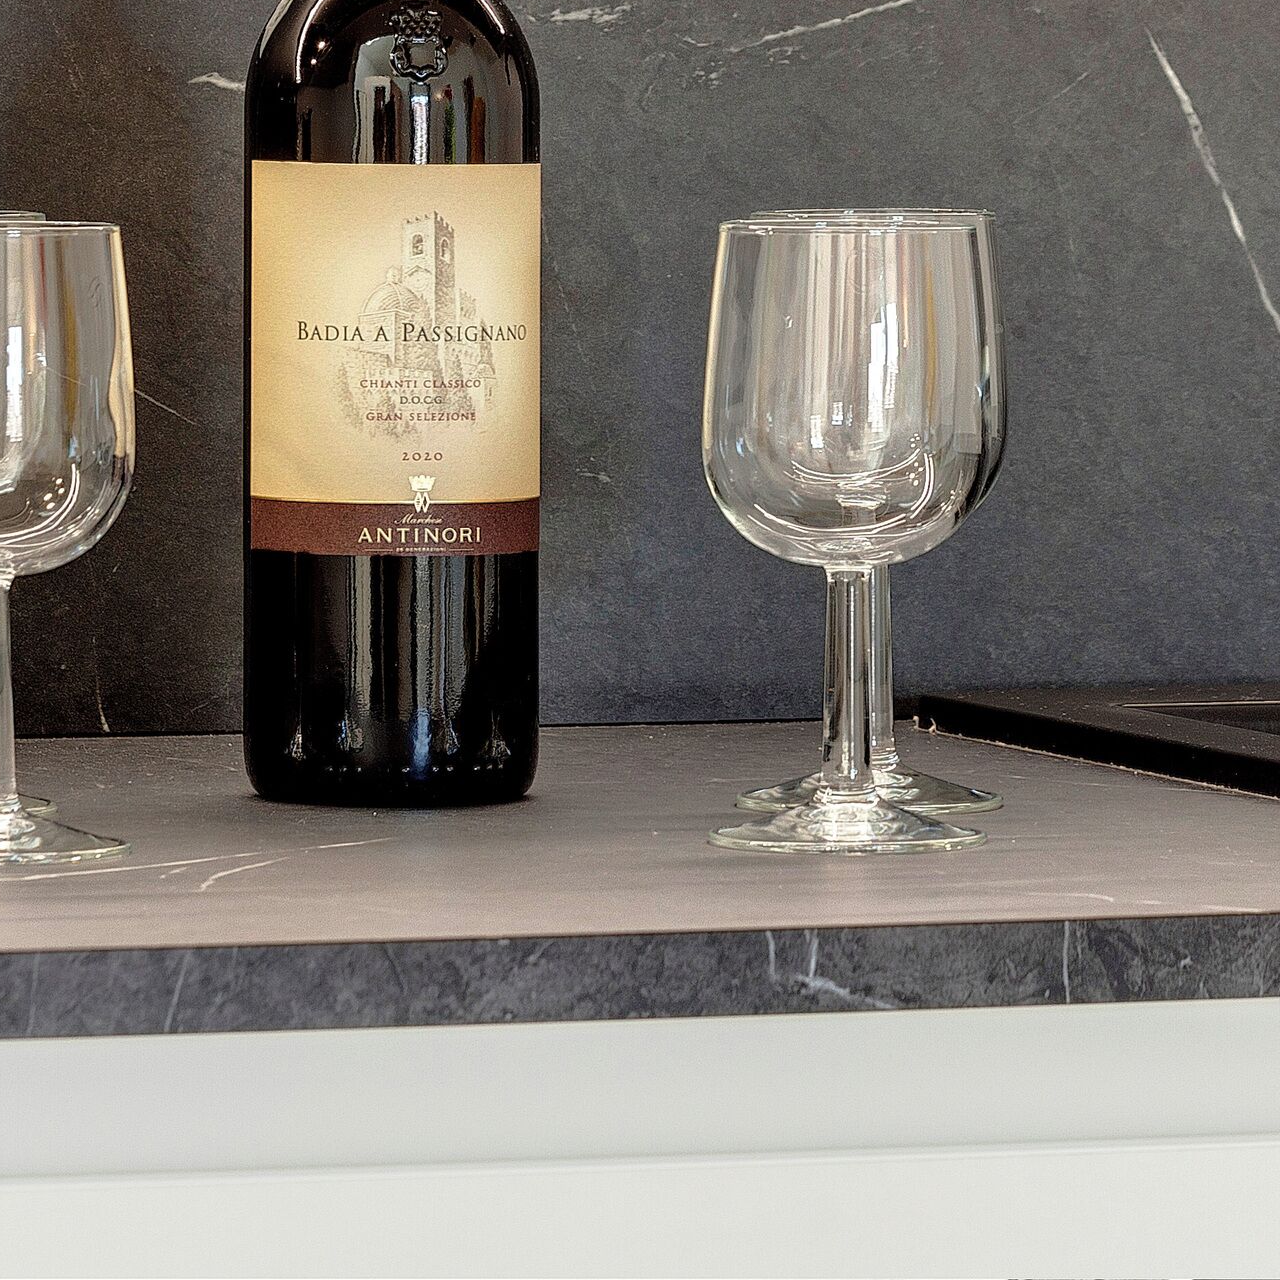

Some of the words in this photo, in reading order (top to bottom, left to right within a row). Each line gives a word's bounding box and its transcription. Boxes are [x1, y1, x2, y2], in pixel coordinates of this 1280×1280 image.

[297, 320, 365, 342] BADIA
[373, 324, 390, 342] A
[402, 322, 527, 342] PASSIGNANO
[359, 379, 417, 389] CHIANTI
[423, 379, 481, 389] CLASSICO
[365, 412, 403, 421] GRAN
[409, 411, 477, 421] SELEZIONE
[402, 451, 443, 461] 2020
[357, 527, 481, 544] ANTINORI
